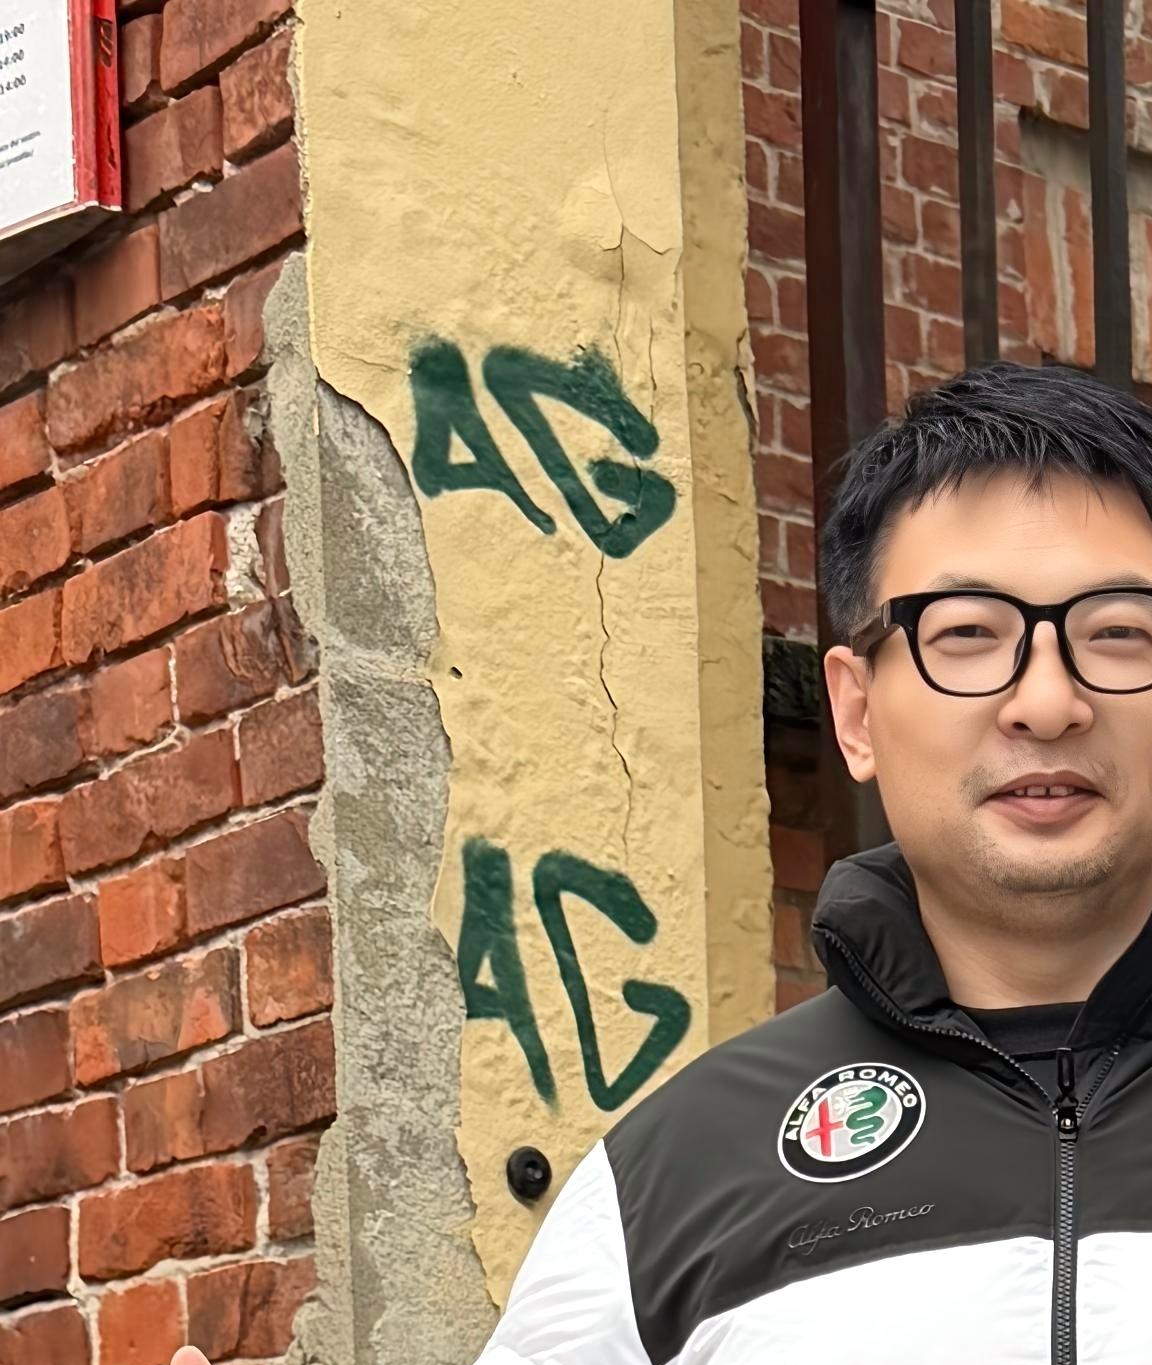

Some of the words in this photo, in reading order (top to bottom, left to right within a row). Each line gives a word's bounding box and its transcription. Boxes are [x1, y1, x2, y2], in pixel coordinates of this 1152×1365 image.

[785, 1087, 827, 1141] ALFA
[838, 1068, 918, 1108] ROMEO
[788, 1219, 840, 1256] Alfa
[847, 1203, 936, 1232] Romeo
